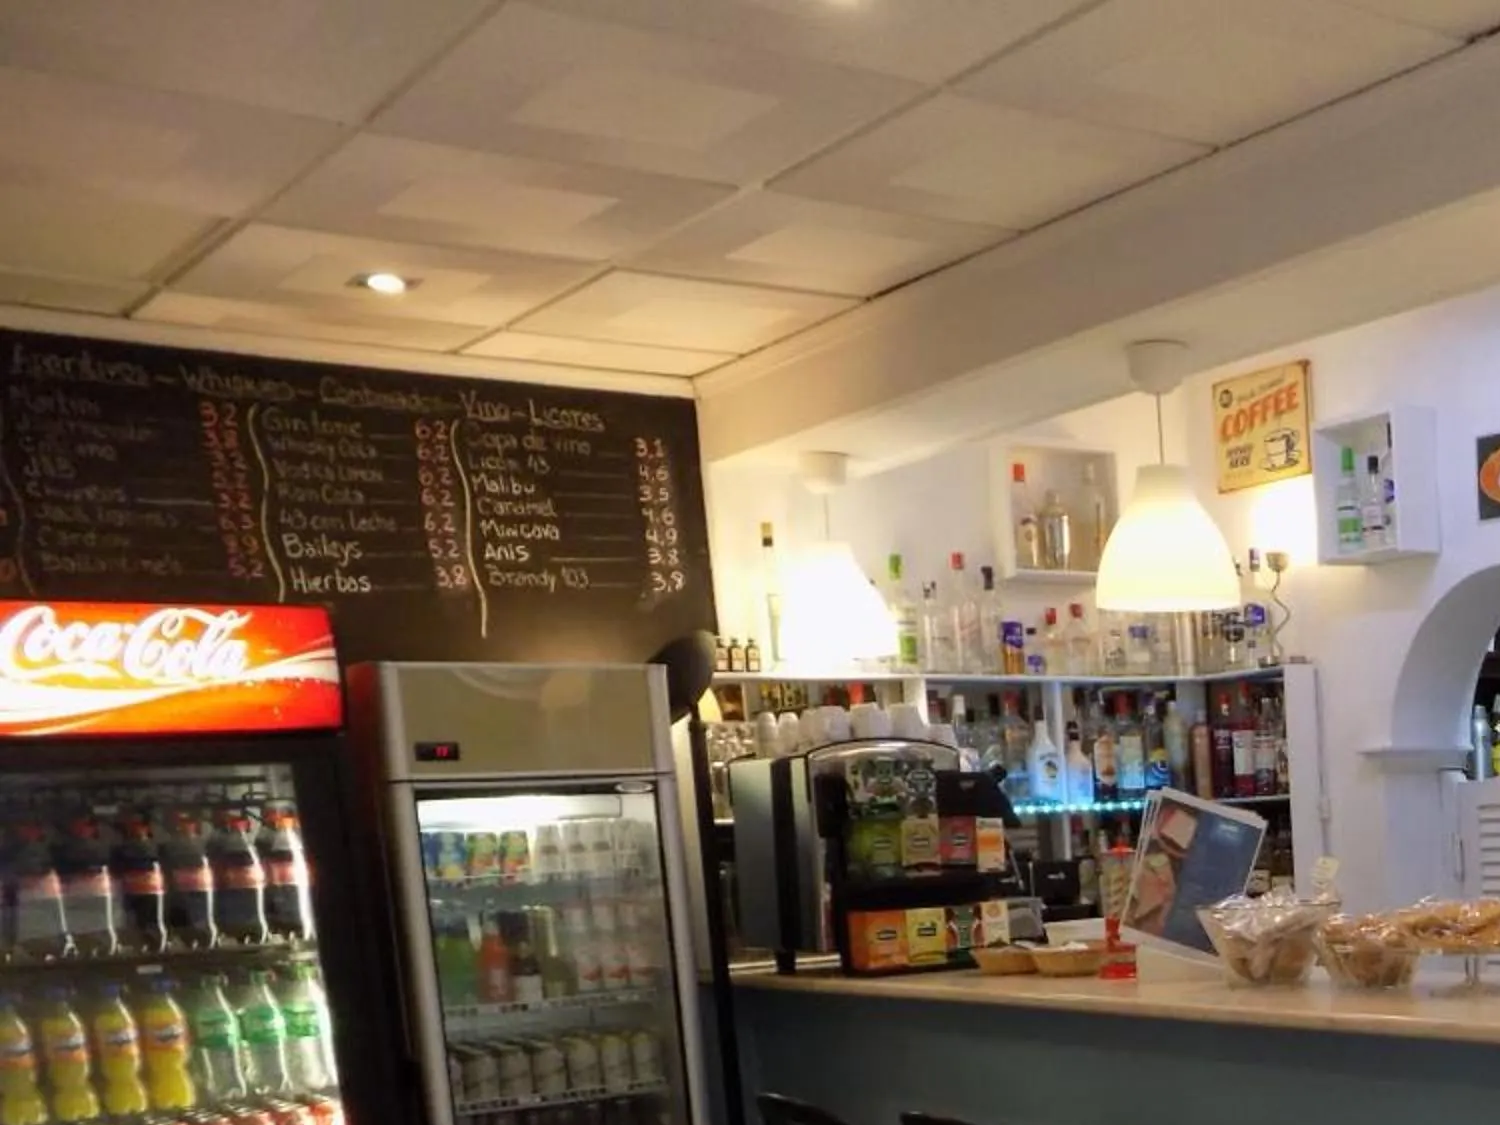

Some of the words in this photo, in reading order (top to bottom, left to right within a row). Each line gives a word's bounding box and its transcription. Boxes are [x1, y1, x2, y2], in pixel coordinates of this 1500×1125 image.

[1220, 381, 1299, 443] COFFEE
[282, 532, 364, 567] Baileys
[289, 565, 372, 594] Hierbas
[0, 604, 254, 683] Coca-Cola
